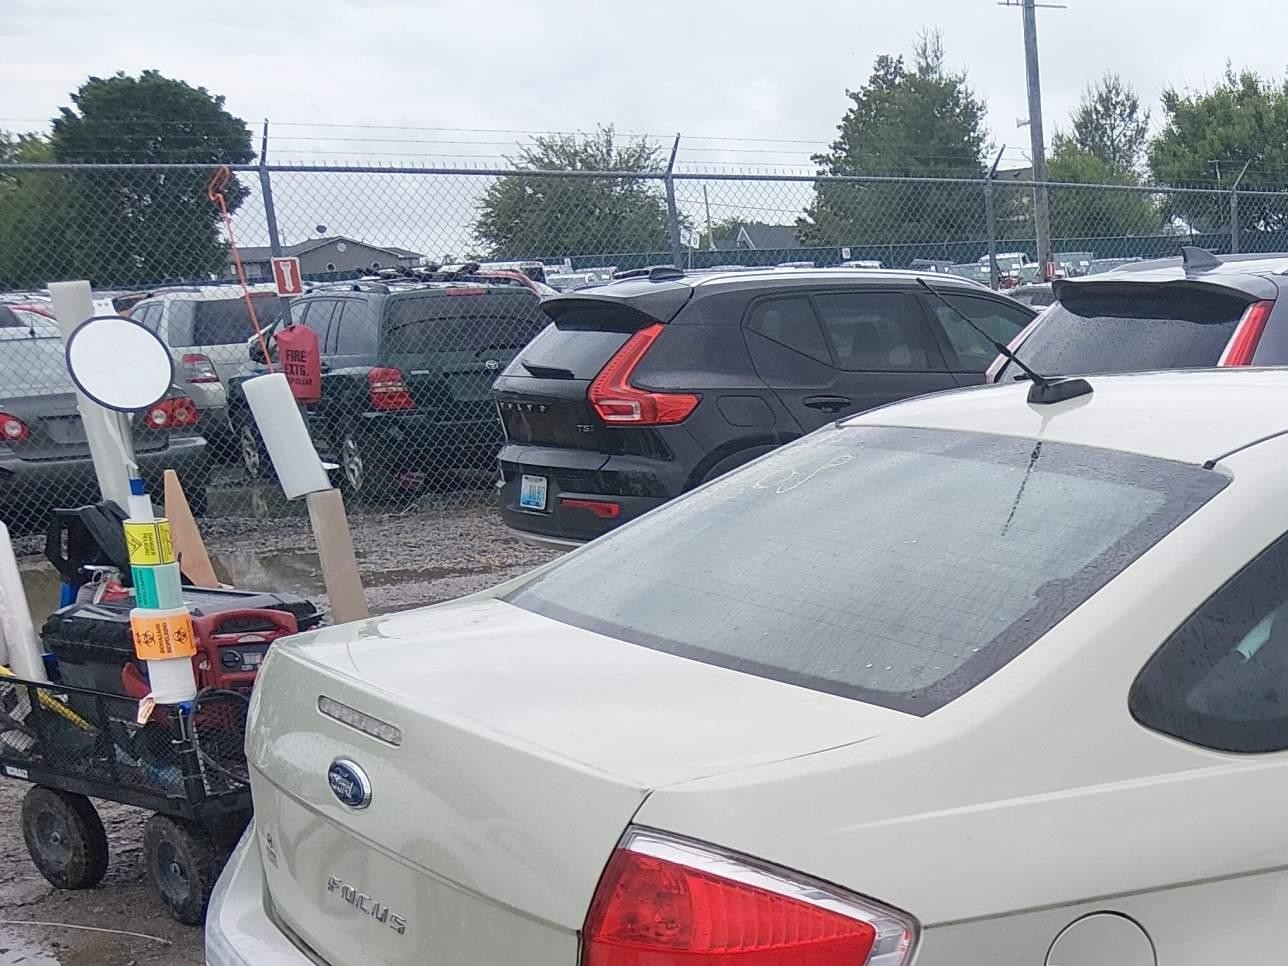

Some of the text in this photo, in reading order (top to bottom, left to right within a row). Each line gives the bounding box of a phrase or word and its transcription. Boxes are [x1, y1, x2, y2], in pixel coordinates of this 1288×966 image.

[286, 349, 307, 363] FIRE
[329, 771, 355, 799] Ford
[328, 875, 407, 936] FOCUS
